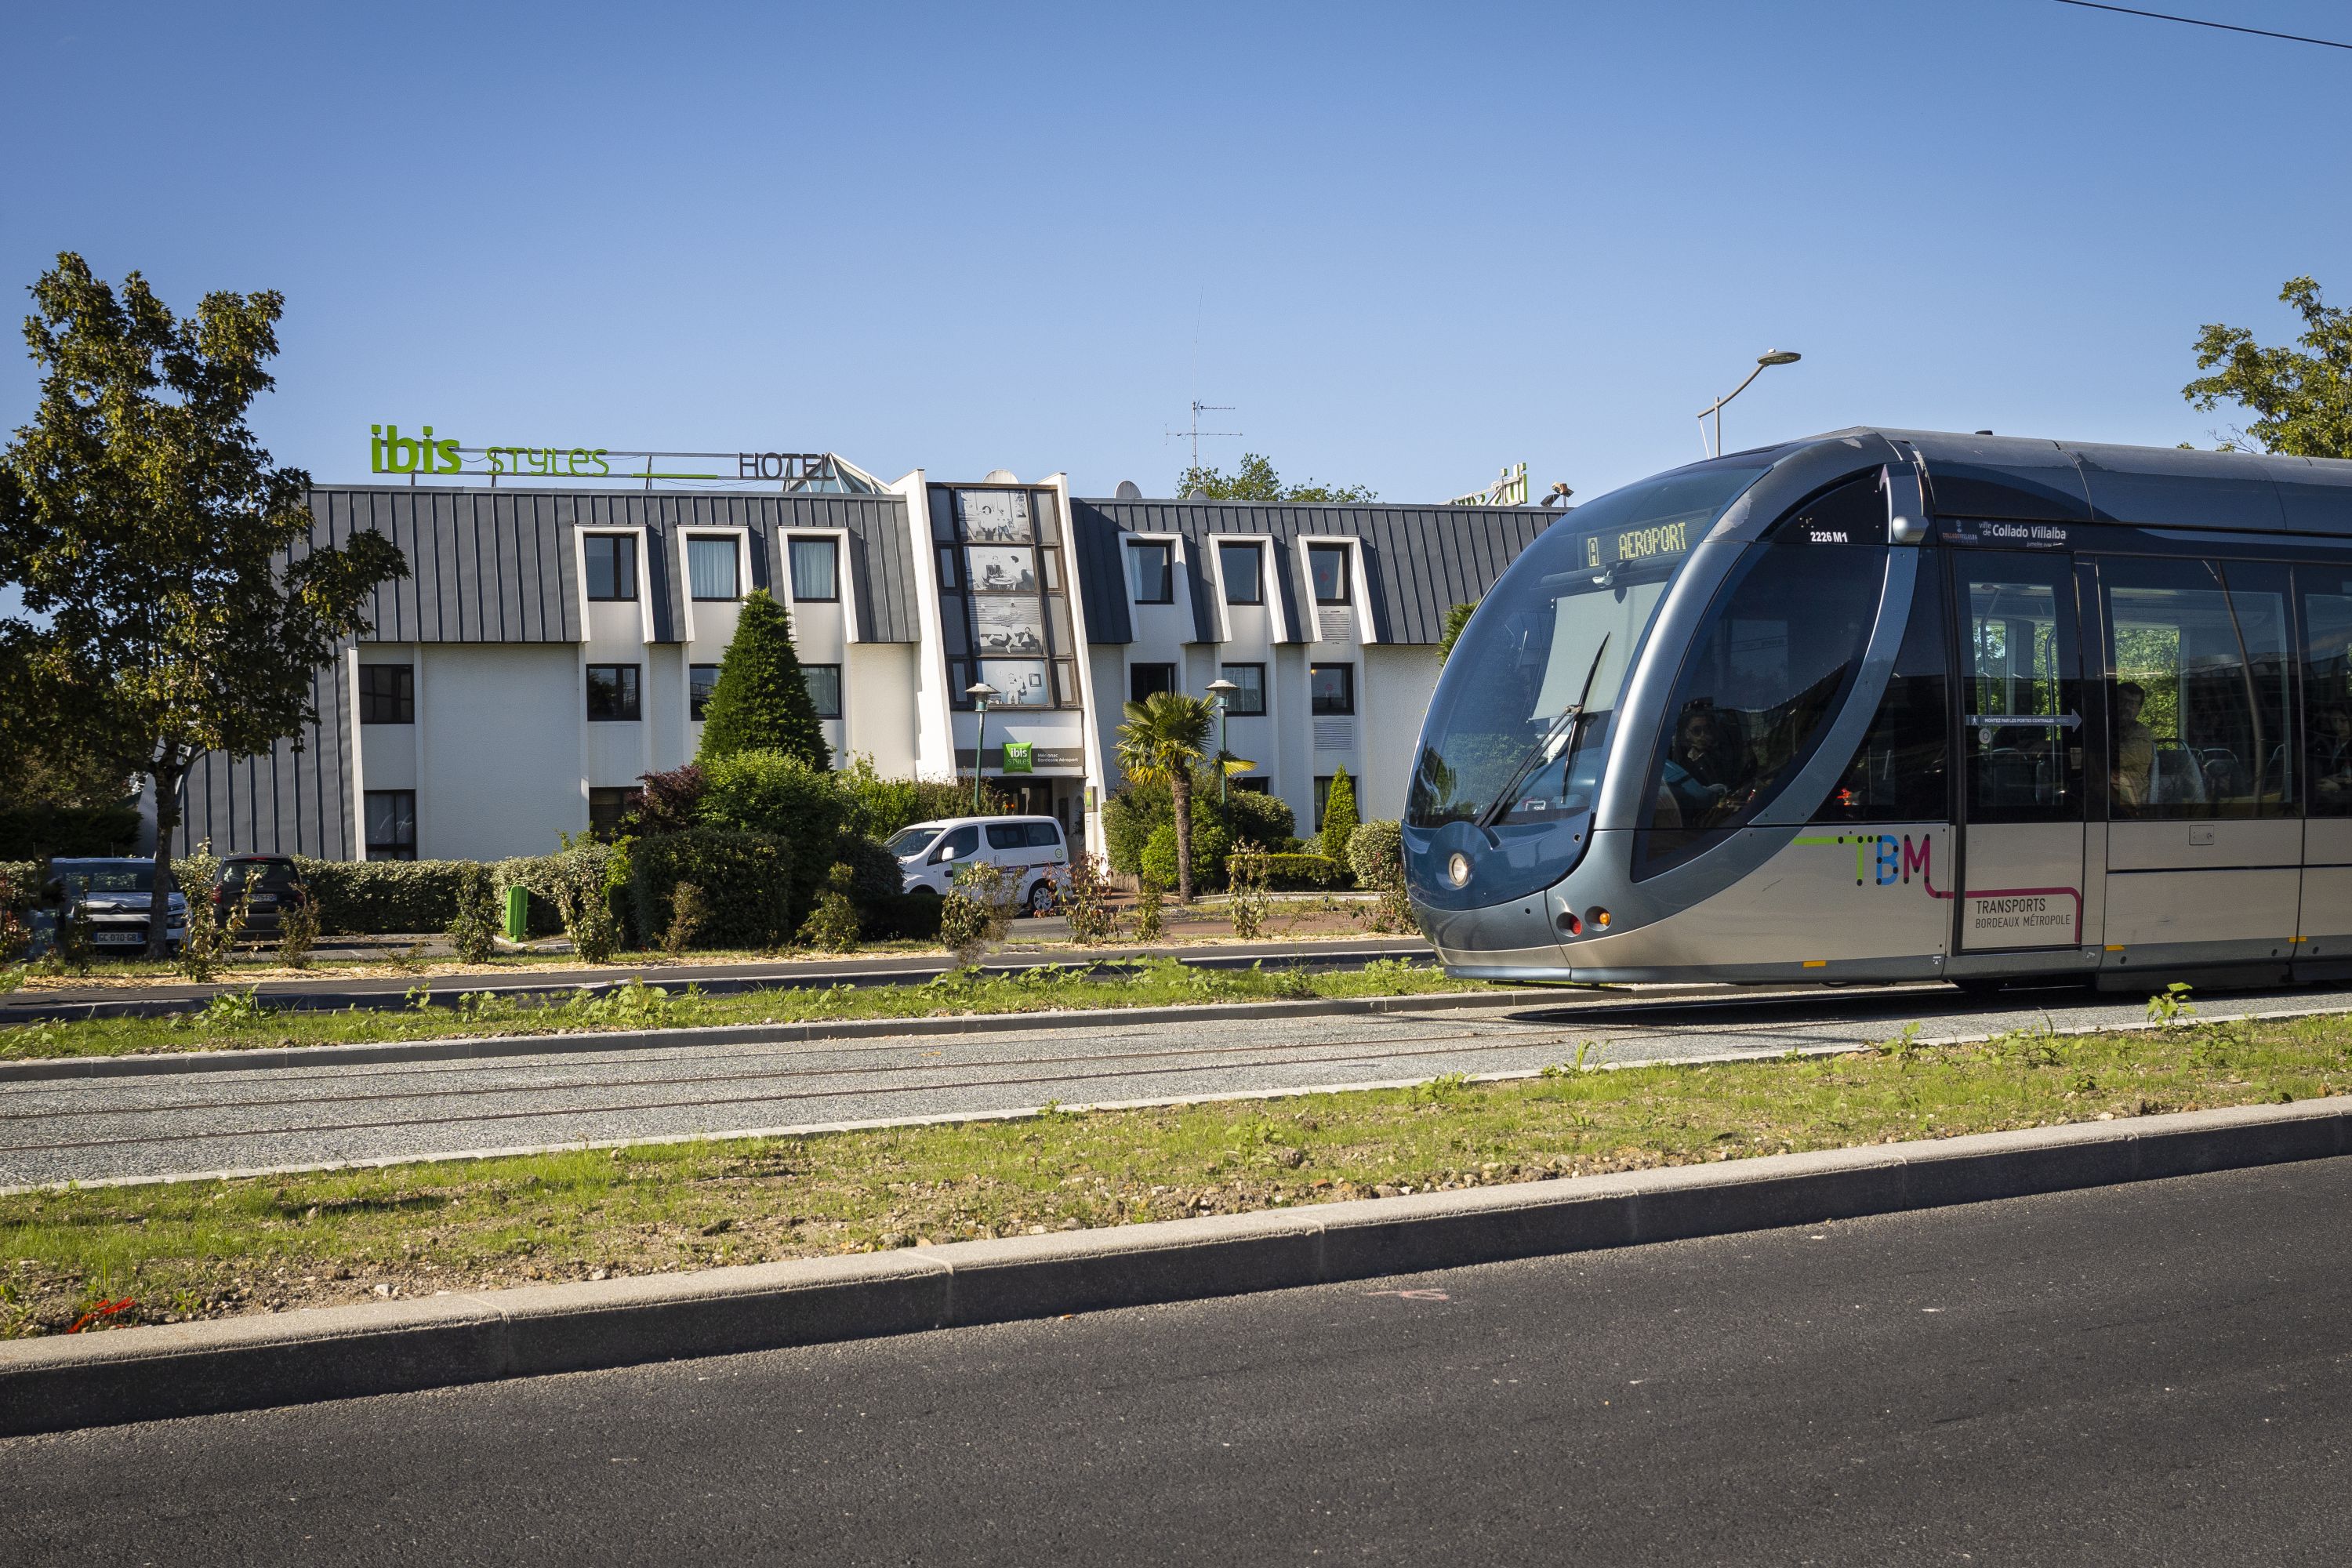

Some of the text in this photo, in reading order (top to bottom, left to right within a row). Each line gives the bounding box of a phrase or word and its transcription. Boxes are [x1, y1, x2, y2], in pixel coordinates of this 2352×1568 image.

[372, 424, 462, 474] ibis
[739, 452, 837, 480] HOTEL
[1979, 521, 1992, 530] ville
[1992, 524, 2067, 539] Collado Villalba
[1618, 522, 1686, 560] AEROPORT
[1810, 532, 1848, 543] 2226 M1
[1011, 747, 1027, 757] ibis
[1838, 833, 1931, 886] TBM
[1976, 898, 2045, 914] TRANSPORTS
[1976, 913, 2071, 928] BORDEAUX MÉTROPOLE
